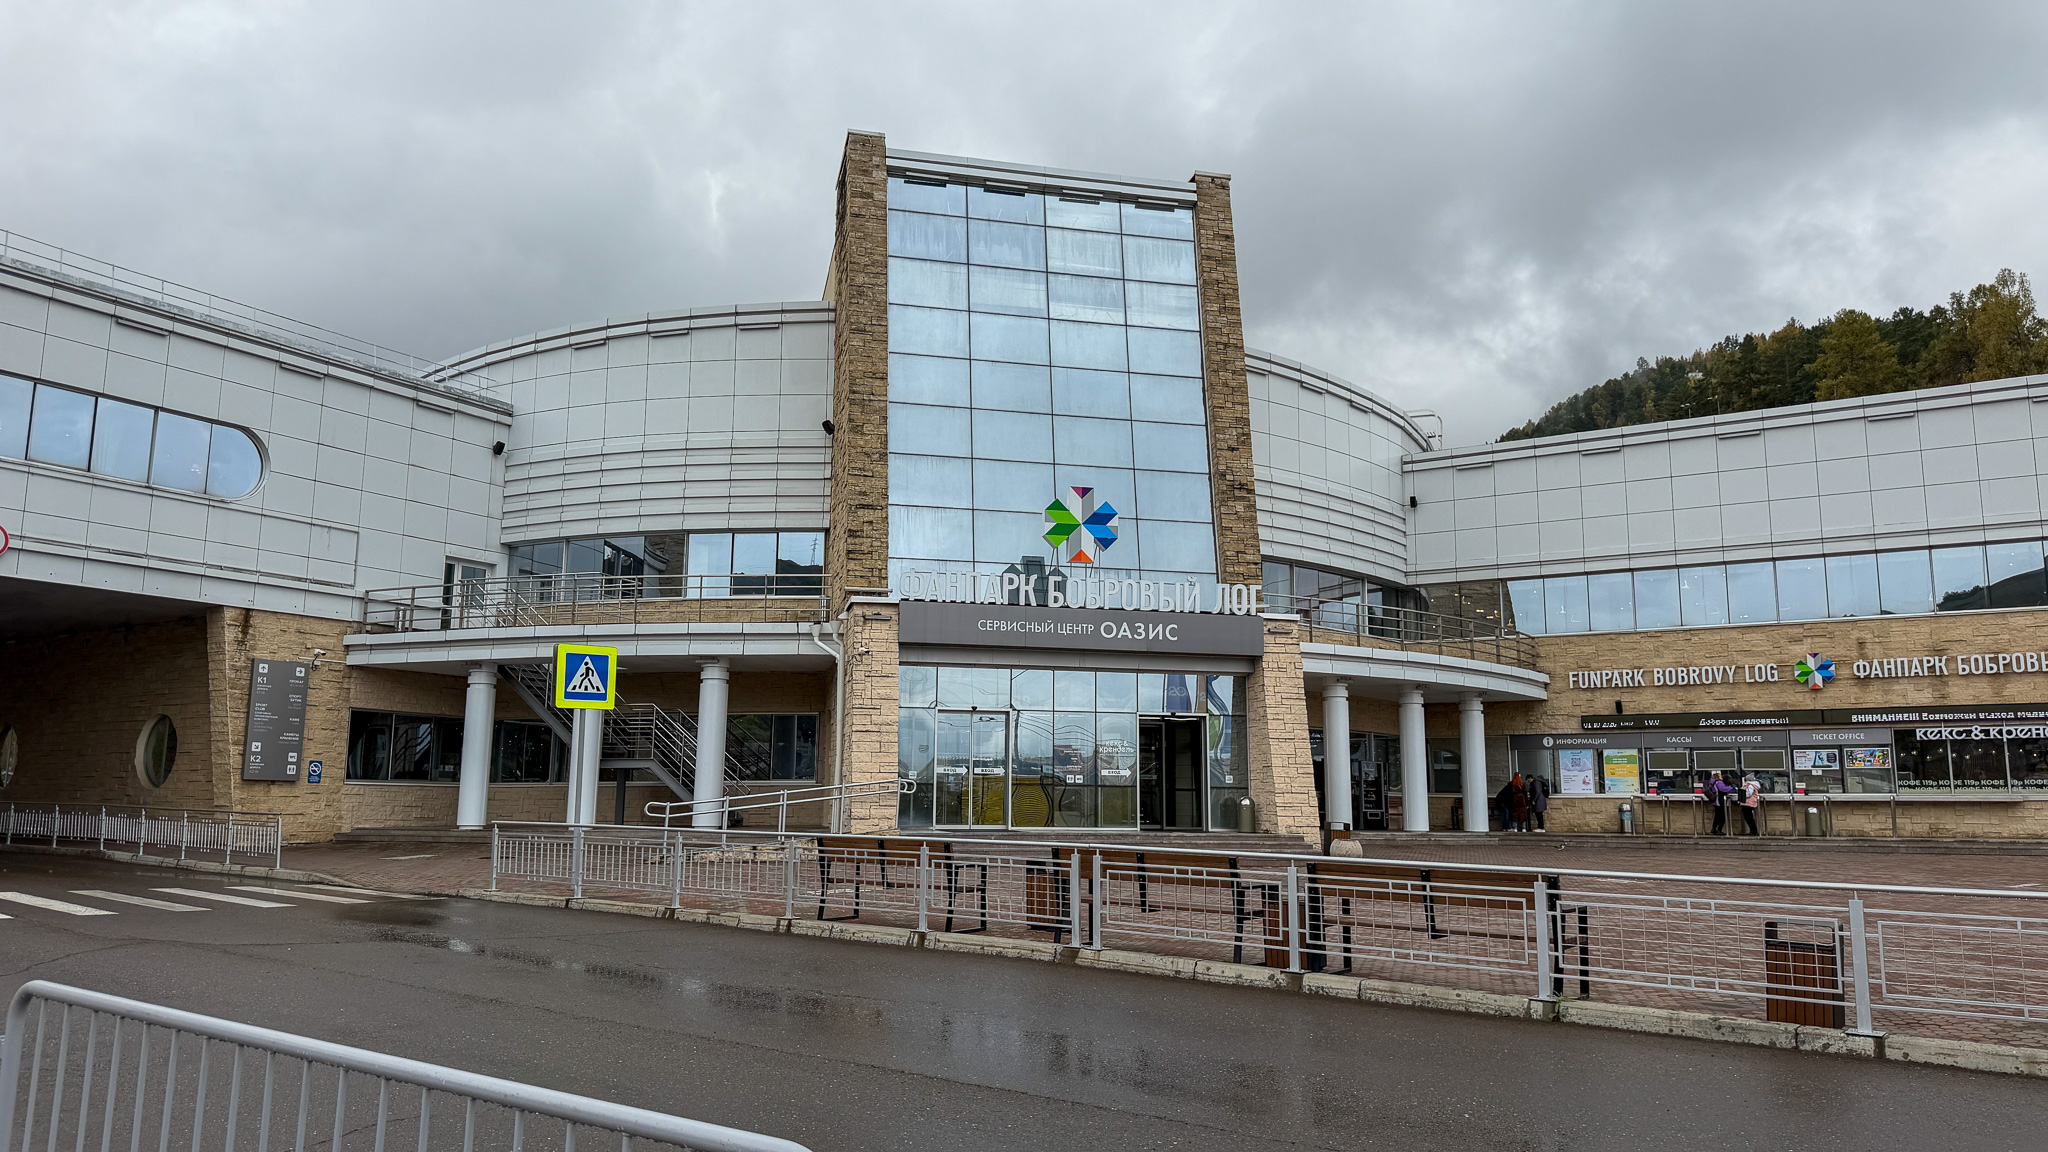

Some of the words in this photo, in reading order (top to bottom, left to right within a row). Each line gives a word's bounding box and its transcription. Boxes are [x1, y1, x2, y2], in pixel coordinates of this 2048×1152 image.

[900, 568, 1038, 606] ФАНПАРК
[1048, 575, 1200, 613] БОБРОВЫЙ
[1212, 583, 1262, 616] ЛОГ
[978, 619, 1054, 634] СЕРВИСНЫЙ
[1057, 623, 1094, 635] ЦЕНТР
[1100, 621, 1178, 641] ОАЗИС
[1568, 668, 1646, 689] FUNPARK
[1653, 664, 1736, 686] BOBROVY
[1745, 663, 1779, 683] LOG
[1853, 655, 1949, 679] ФАНПАРК
[1556, 737, 1607, 745] ИНФОРМАЦИЯ
[1712, 735, 1735, 743] TICKET
[1838, 732, 1865, 740] OFFICE
[1971, 725, 1985, 740] &
[1989, 726, 2048, 742] крен
